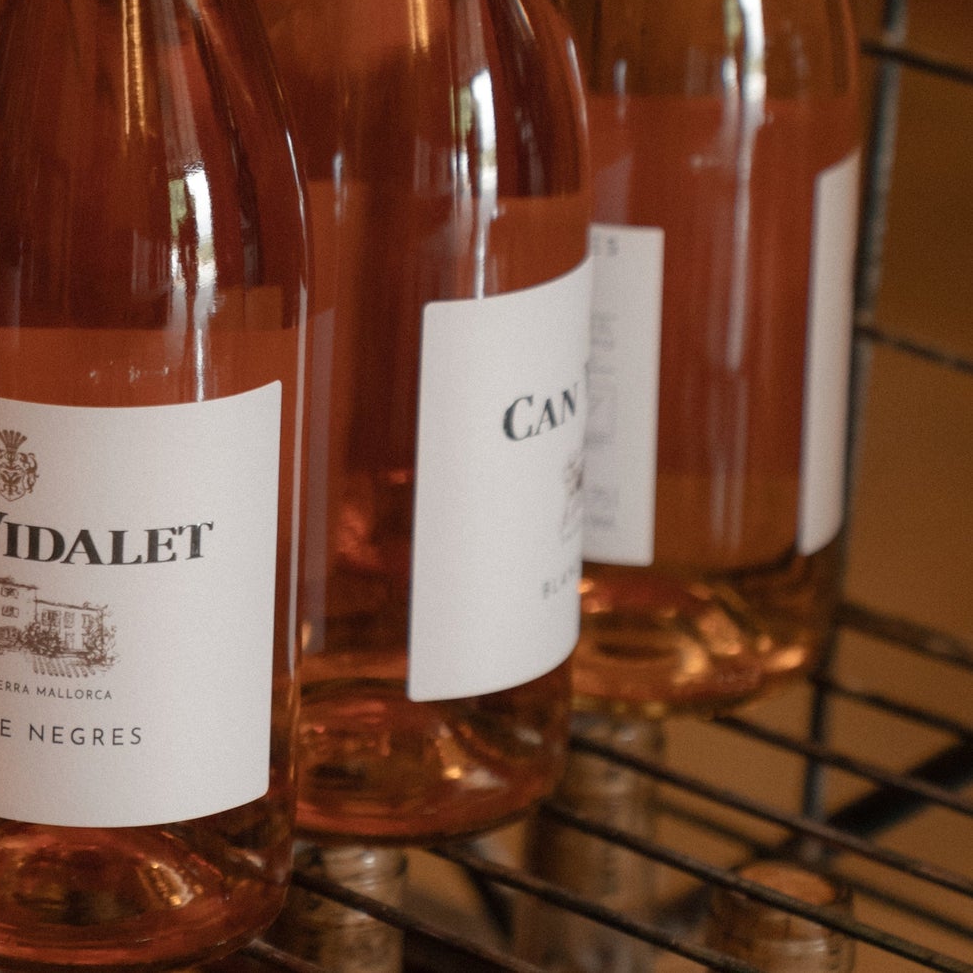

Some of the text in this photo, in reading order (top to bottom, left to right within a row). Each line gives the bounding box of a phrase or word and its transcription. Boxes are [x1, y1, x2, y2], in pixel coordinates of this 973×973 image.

[503, 382, 580, 442] CAN
[36, 685, 112, 700] MALLORCA
[29, 723, 142, 747] NEGRES
